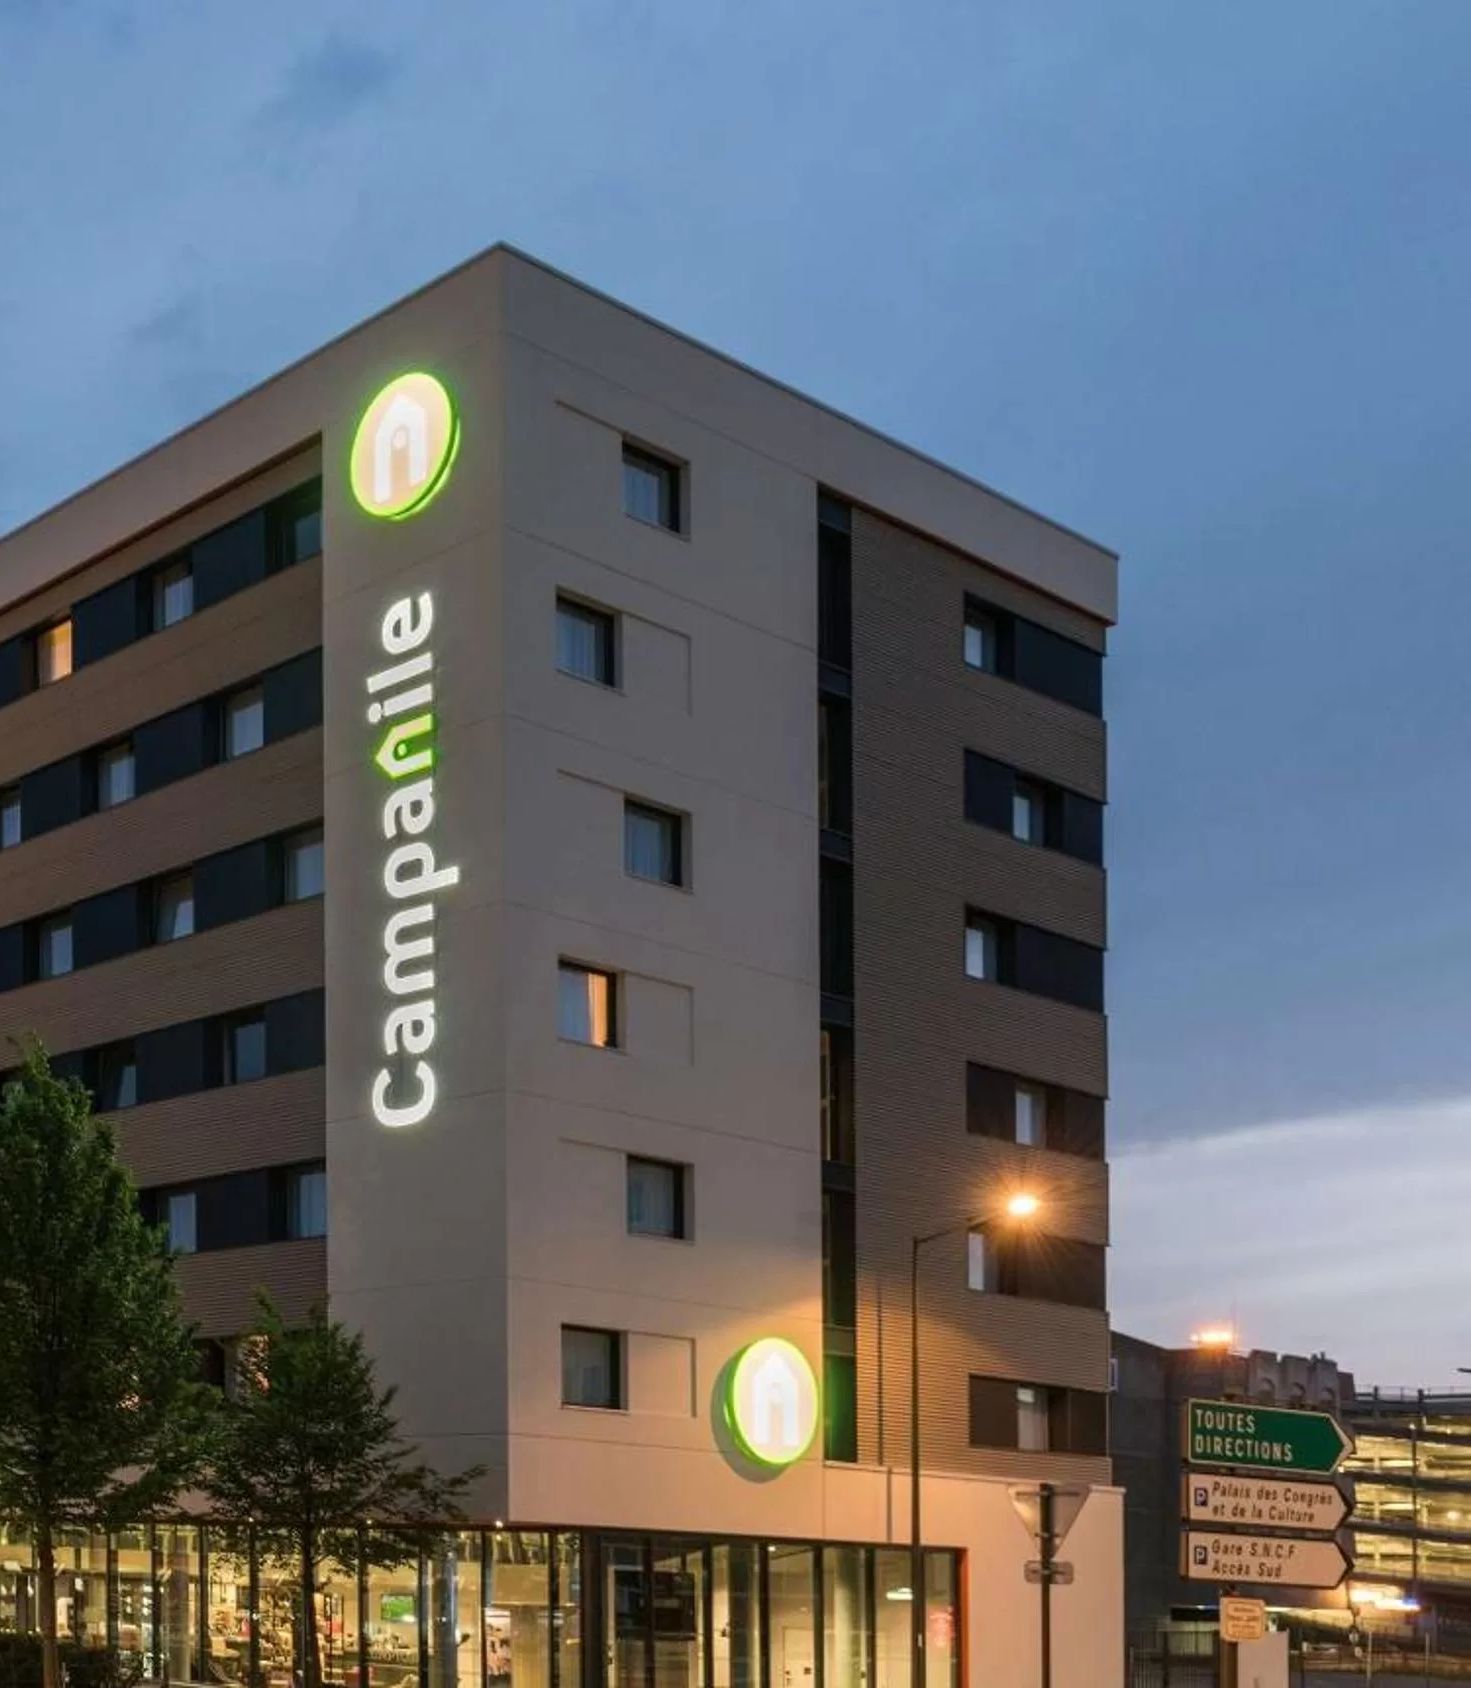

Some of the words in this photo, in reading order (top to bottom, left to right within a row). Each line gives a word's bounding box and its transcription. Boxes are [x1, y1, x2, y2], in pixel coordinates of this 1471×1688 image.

[366, 591, 460, 1129] Campanile
[1195, 1409, 1256, 1434] TOUTES
[1195, 1434, 1293, 1462] DIRECTIONS
[1212, 1481, 1251, 1499] Palais
[1257, 1485, 1278, 1500] des
[1283, 1488, 1332, 1507] Congrès
[1212, 1504, 1225, 1517] et
[1231, 1503, 1246, 1517] de
[1251, 1504, 1263, 1518] la
[1268, 1506, 1315, 1523] Culture
[1211, 1539, 1243, 1556] Gare
[1212, 1559, 1251, 1576] Accès
[1258, 1562, 1282, 1577] Sud
